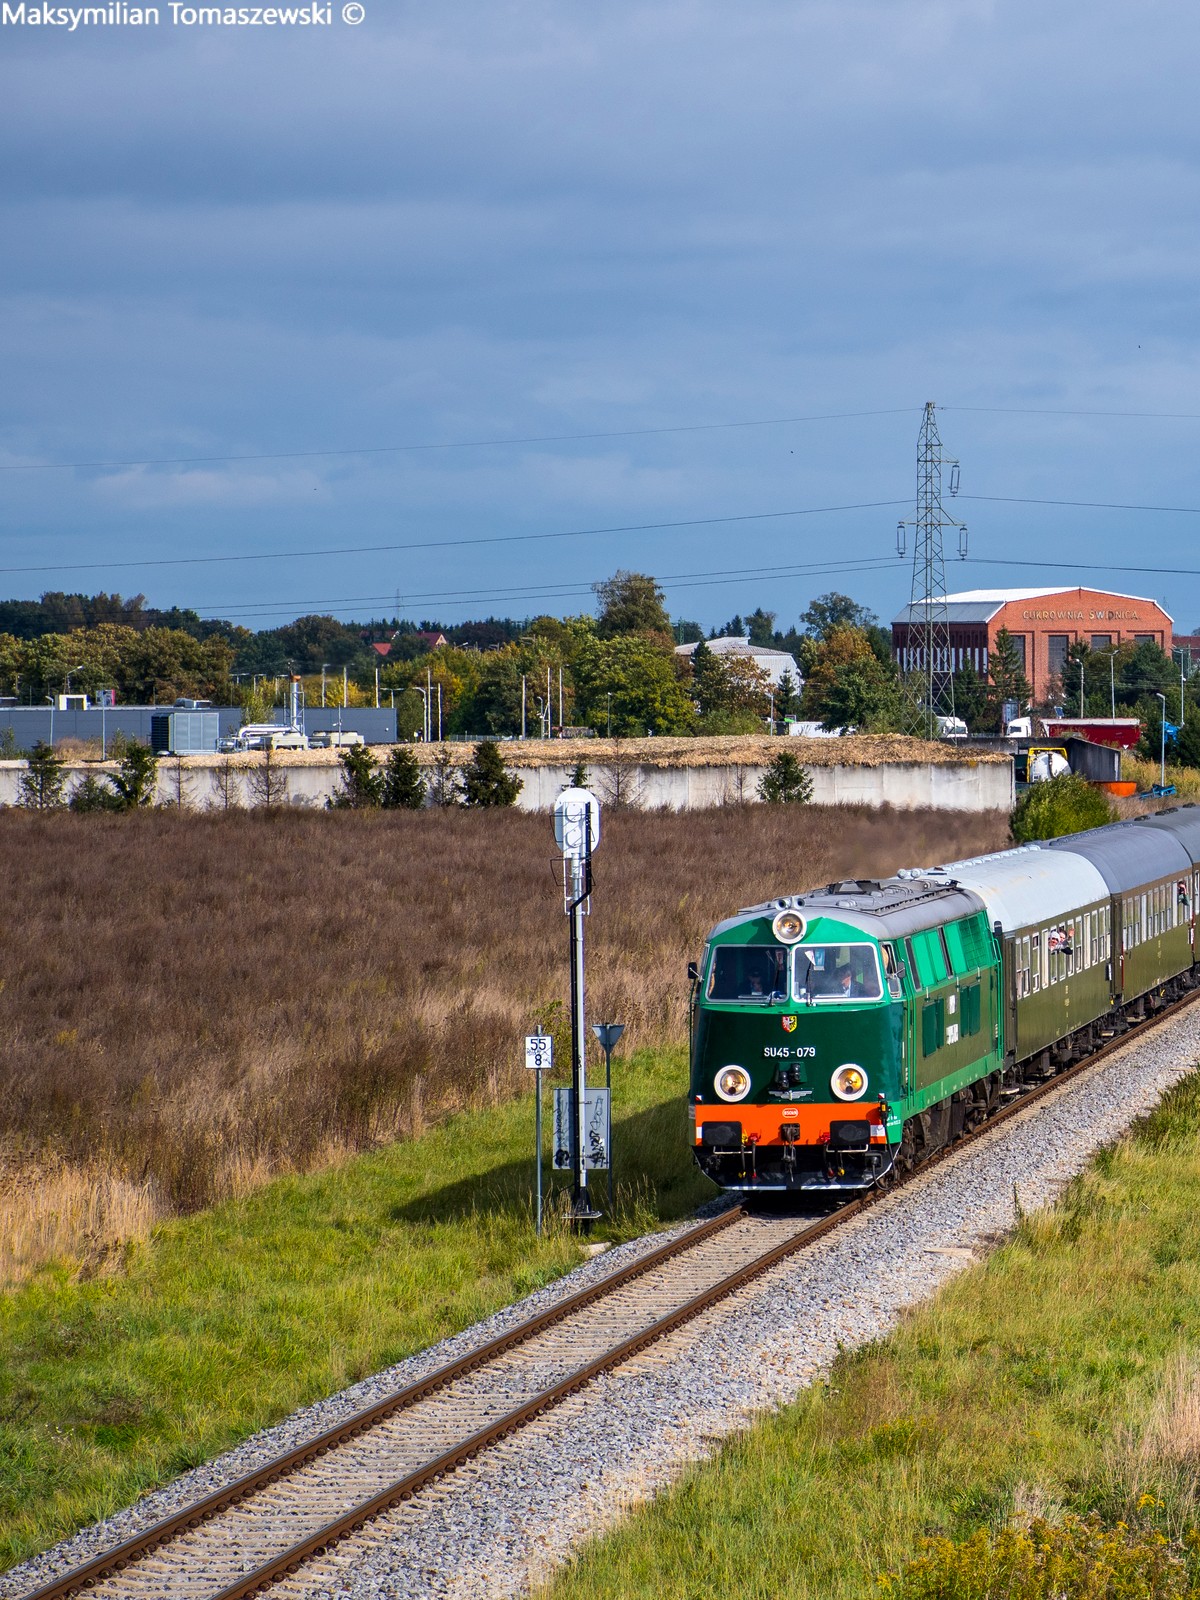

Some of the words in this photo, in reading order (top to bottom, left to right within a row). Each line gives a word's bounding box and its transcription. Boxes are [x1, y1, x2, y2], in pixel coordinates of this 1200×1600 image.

[1023, 610, 1084, 620] CUKROWNIA
[530, 1038, 547, 1050] 55
[764, 1047, 816, 1058] SU45-079
[535, 1054, 542, 1066] 8
